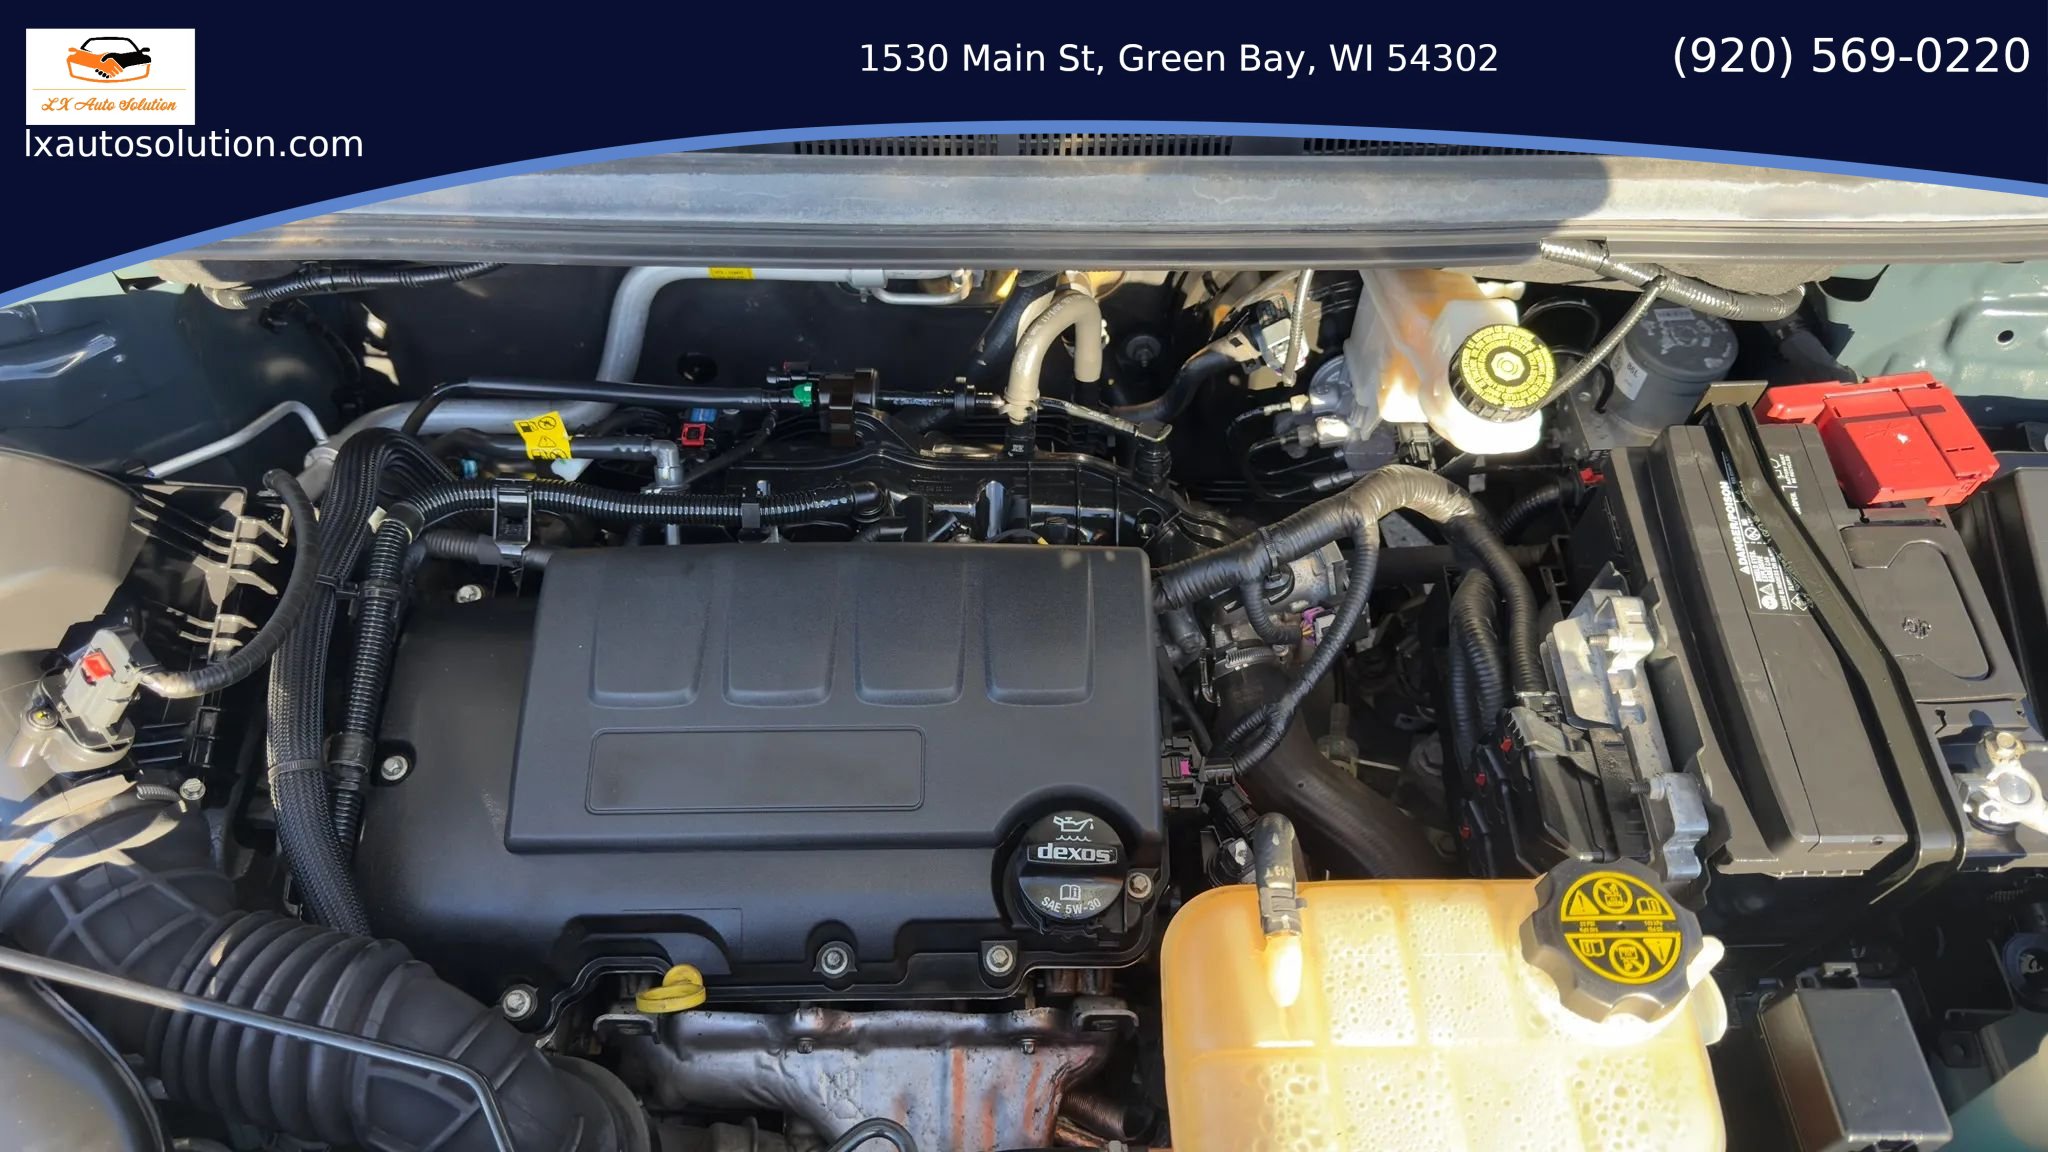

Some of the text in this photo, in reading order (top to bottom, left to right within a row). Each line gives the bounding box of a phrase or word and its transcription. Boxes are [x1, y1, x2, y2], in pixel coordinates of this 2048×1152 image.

[1719, 481, 1749, 566] DANGER/POISON
[1037, 842, 1111, 862] dexos
[1041, 896, 1102, 915] SAE 5W-30
